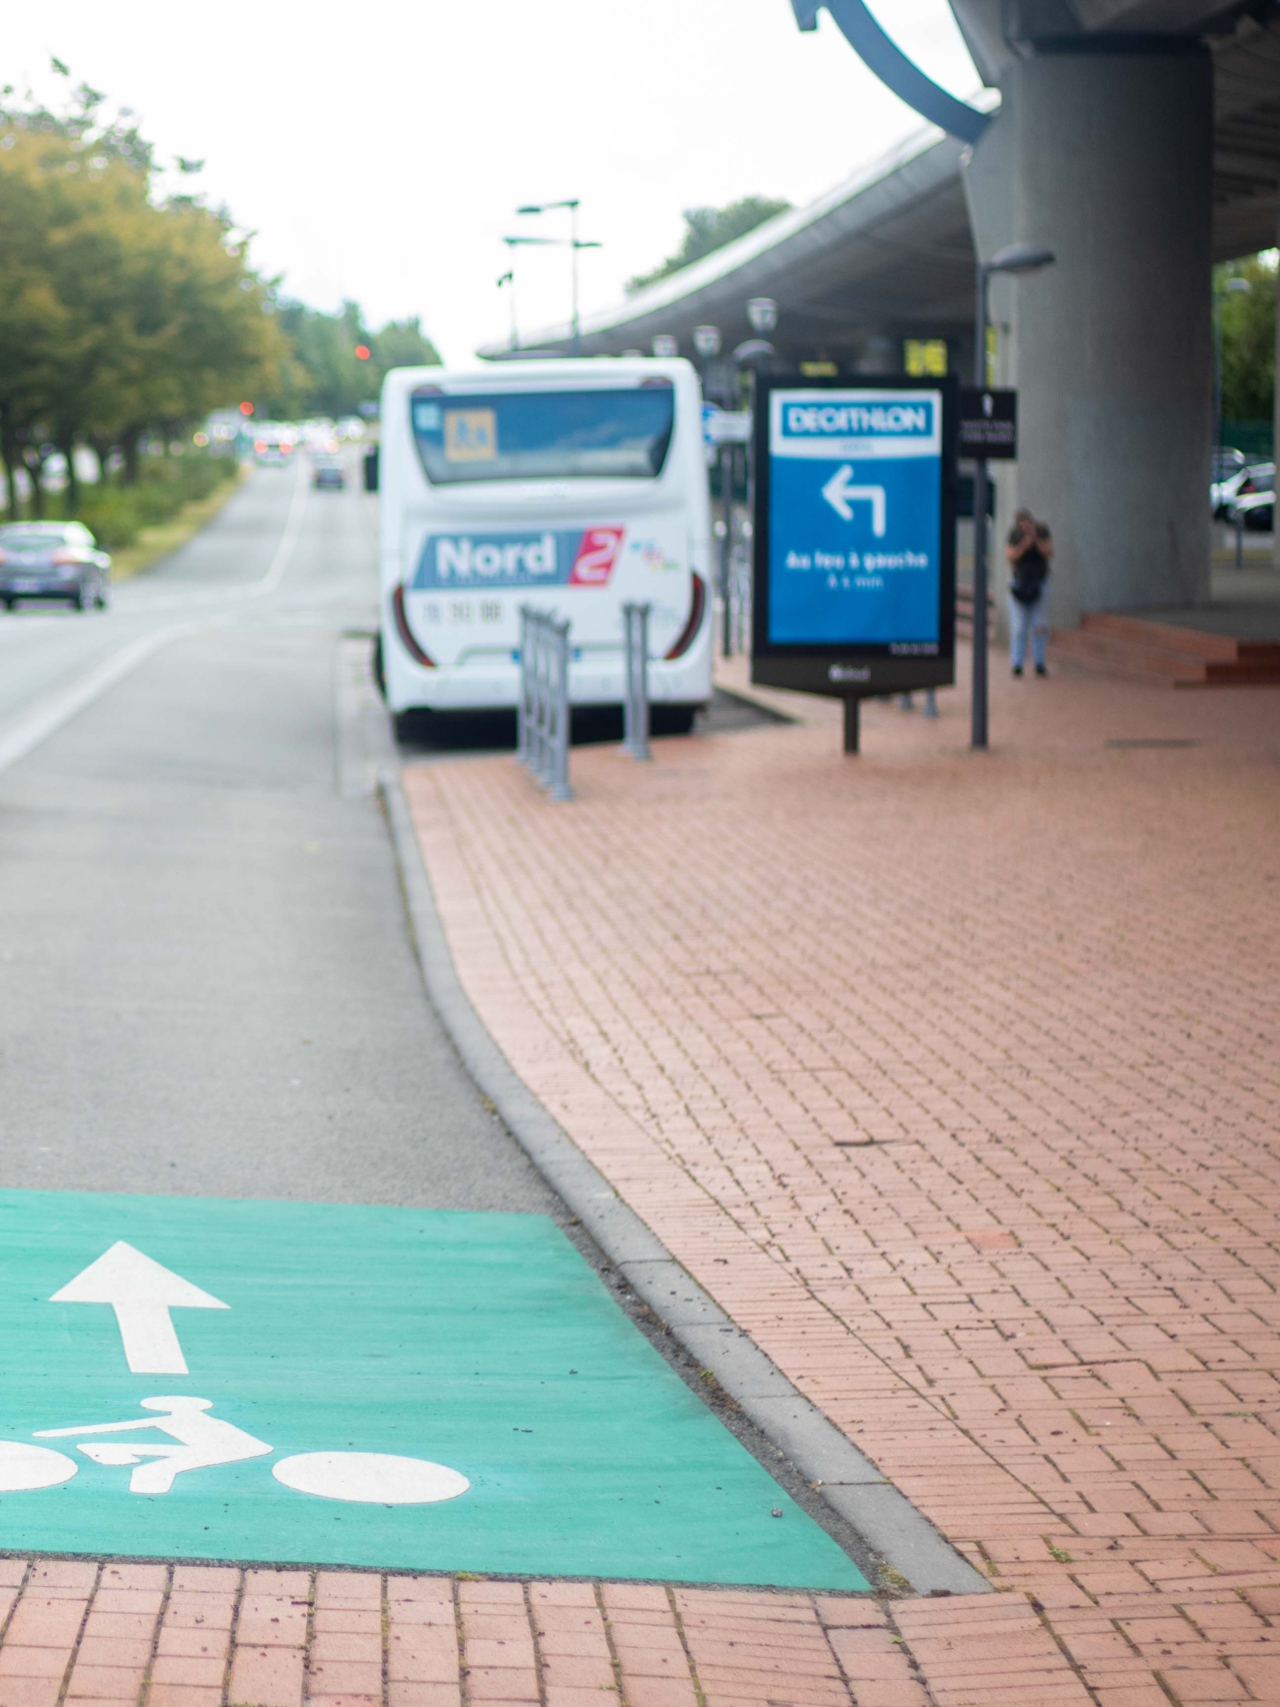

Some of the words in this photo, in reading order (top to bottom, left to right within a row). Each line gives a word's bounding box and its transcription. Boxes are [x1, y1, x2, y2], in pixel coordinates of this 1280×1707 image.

[788, 406, 926, 432] DECATHLON
[436, 532, 556, 577] Nord
[786, 550, 811, 570] Au
[814, 549, 845, 570] feu
[863, 550, 929, 573] gauche
